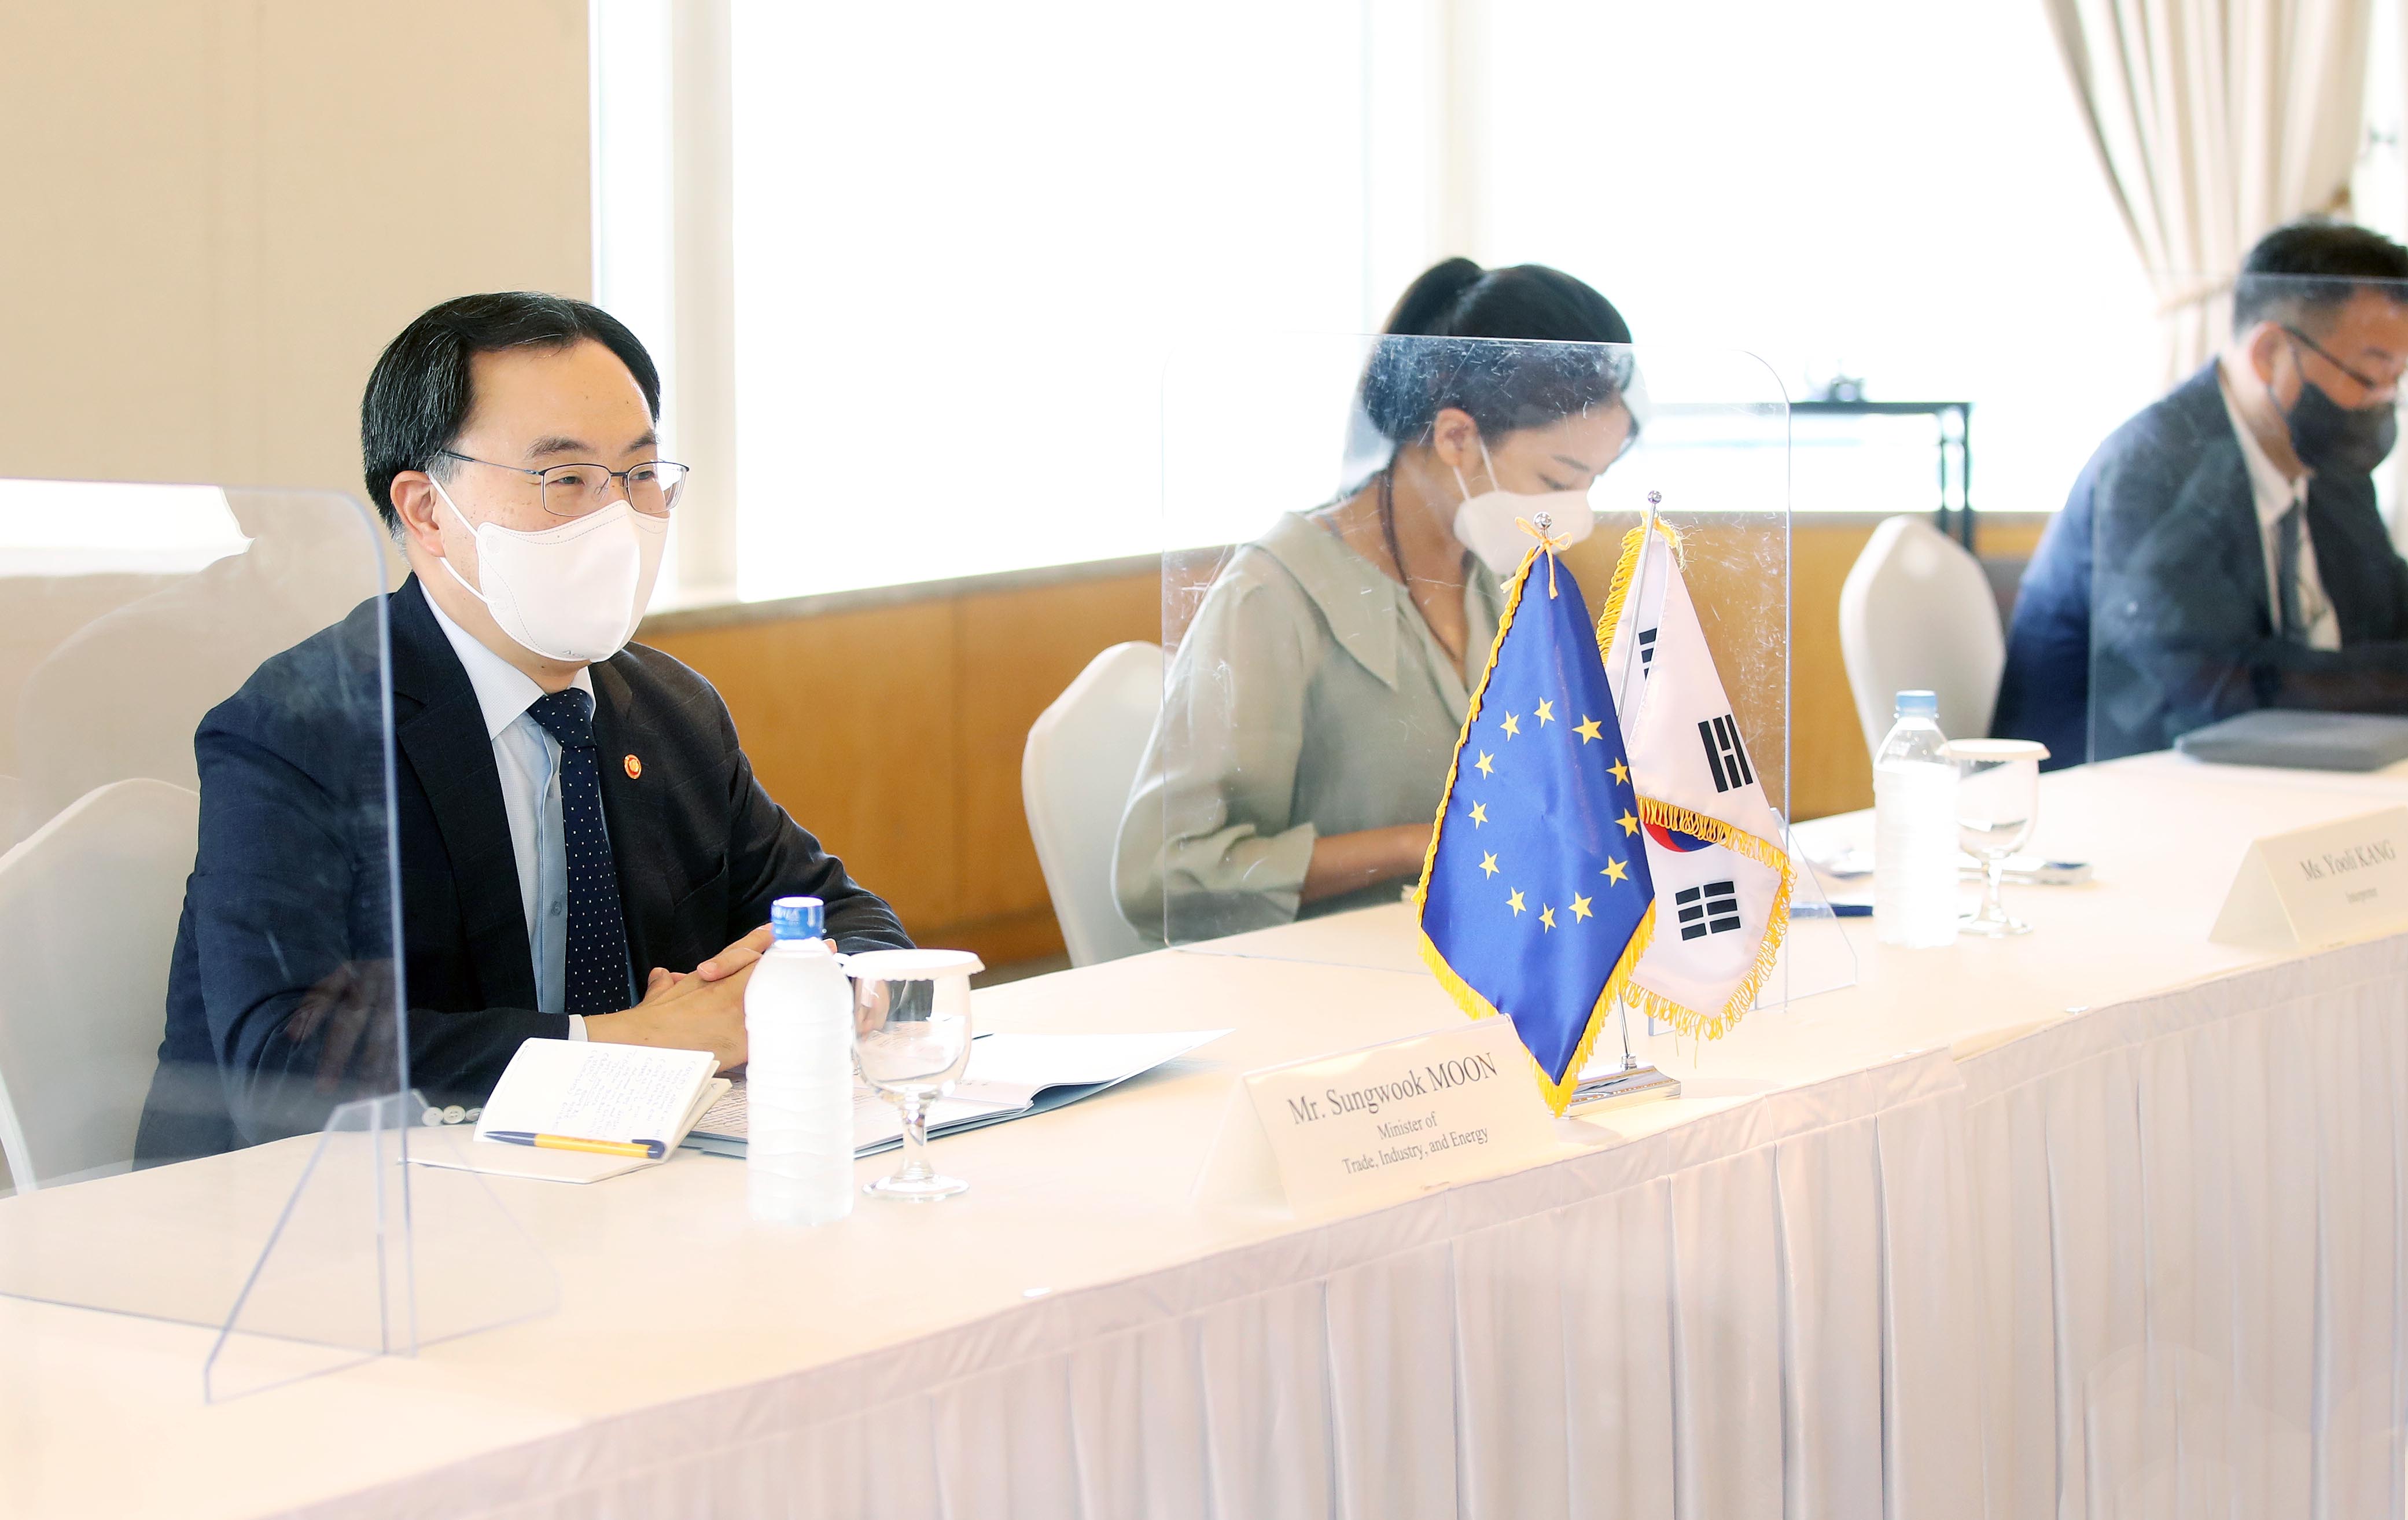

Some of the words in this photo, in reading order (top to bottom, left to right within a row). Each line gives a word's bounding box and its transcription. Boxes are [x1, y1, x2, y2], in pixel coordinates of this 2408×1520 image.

[2355, 838, 2396, 867] KANG
[1287, 1095, 1325, 1125] Mr.
[1326, 1069, 1427, 1114] Sungwook
[1424, 1052, 1498, 1091] MOON
[1376, 1118, 1423, 1140] Minister
[1425, 1111, 1438, 1129] of
[1342, 1154, 1379, 1175] Trade,
[1378, 1146, 1428, 1165] Industry,
[1428, 1134, 1449, 1153] and
[1449, 1128, 1489, 1147] Energy
